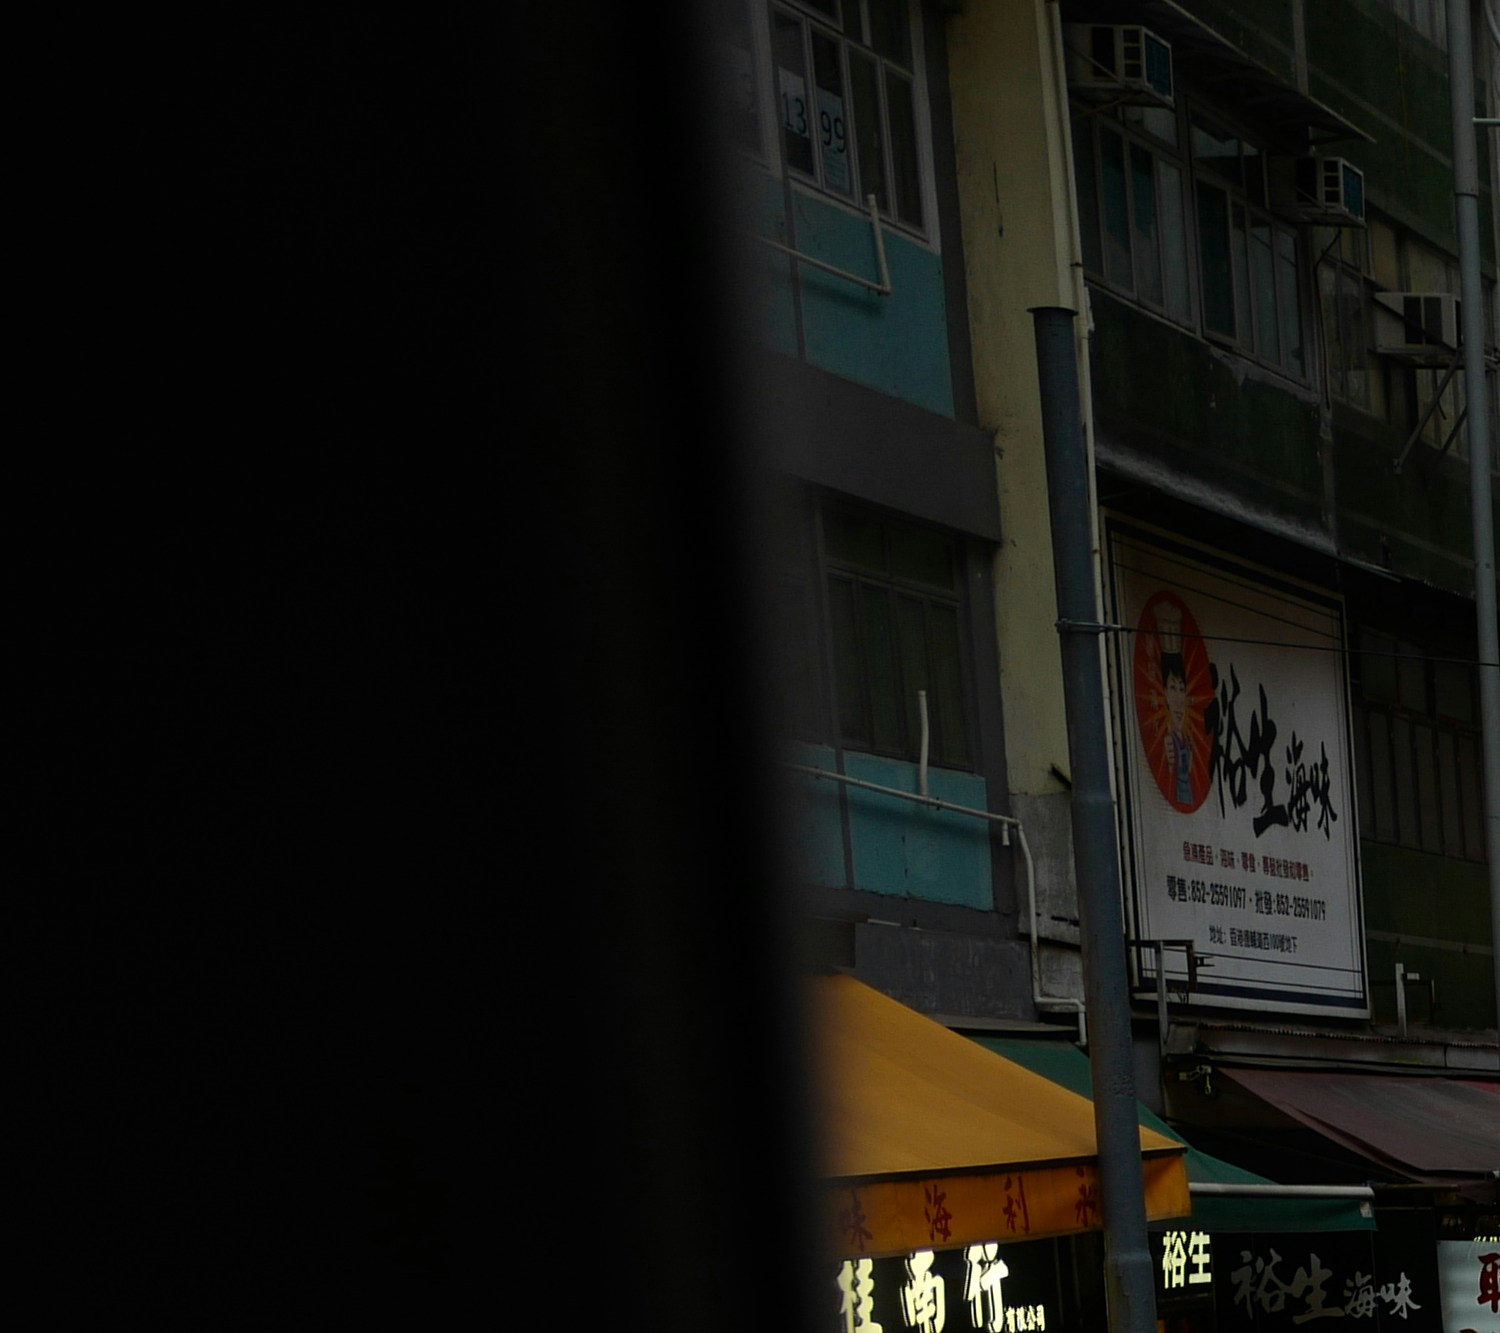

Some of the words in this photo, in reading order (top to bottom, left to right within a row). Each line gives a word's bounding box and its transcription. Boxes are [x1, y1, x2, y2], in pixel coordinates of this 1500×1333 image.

[1162, 1230, 1212, 1290] 裕生
[1230, 1247, 1422, 1326] 裕生海味
